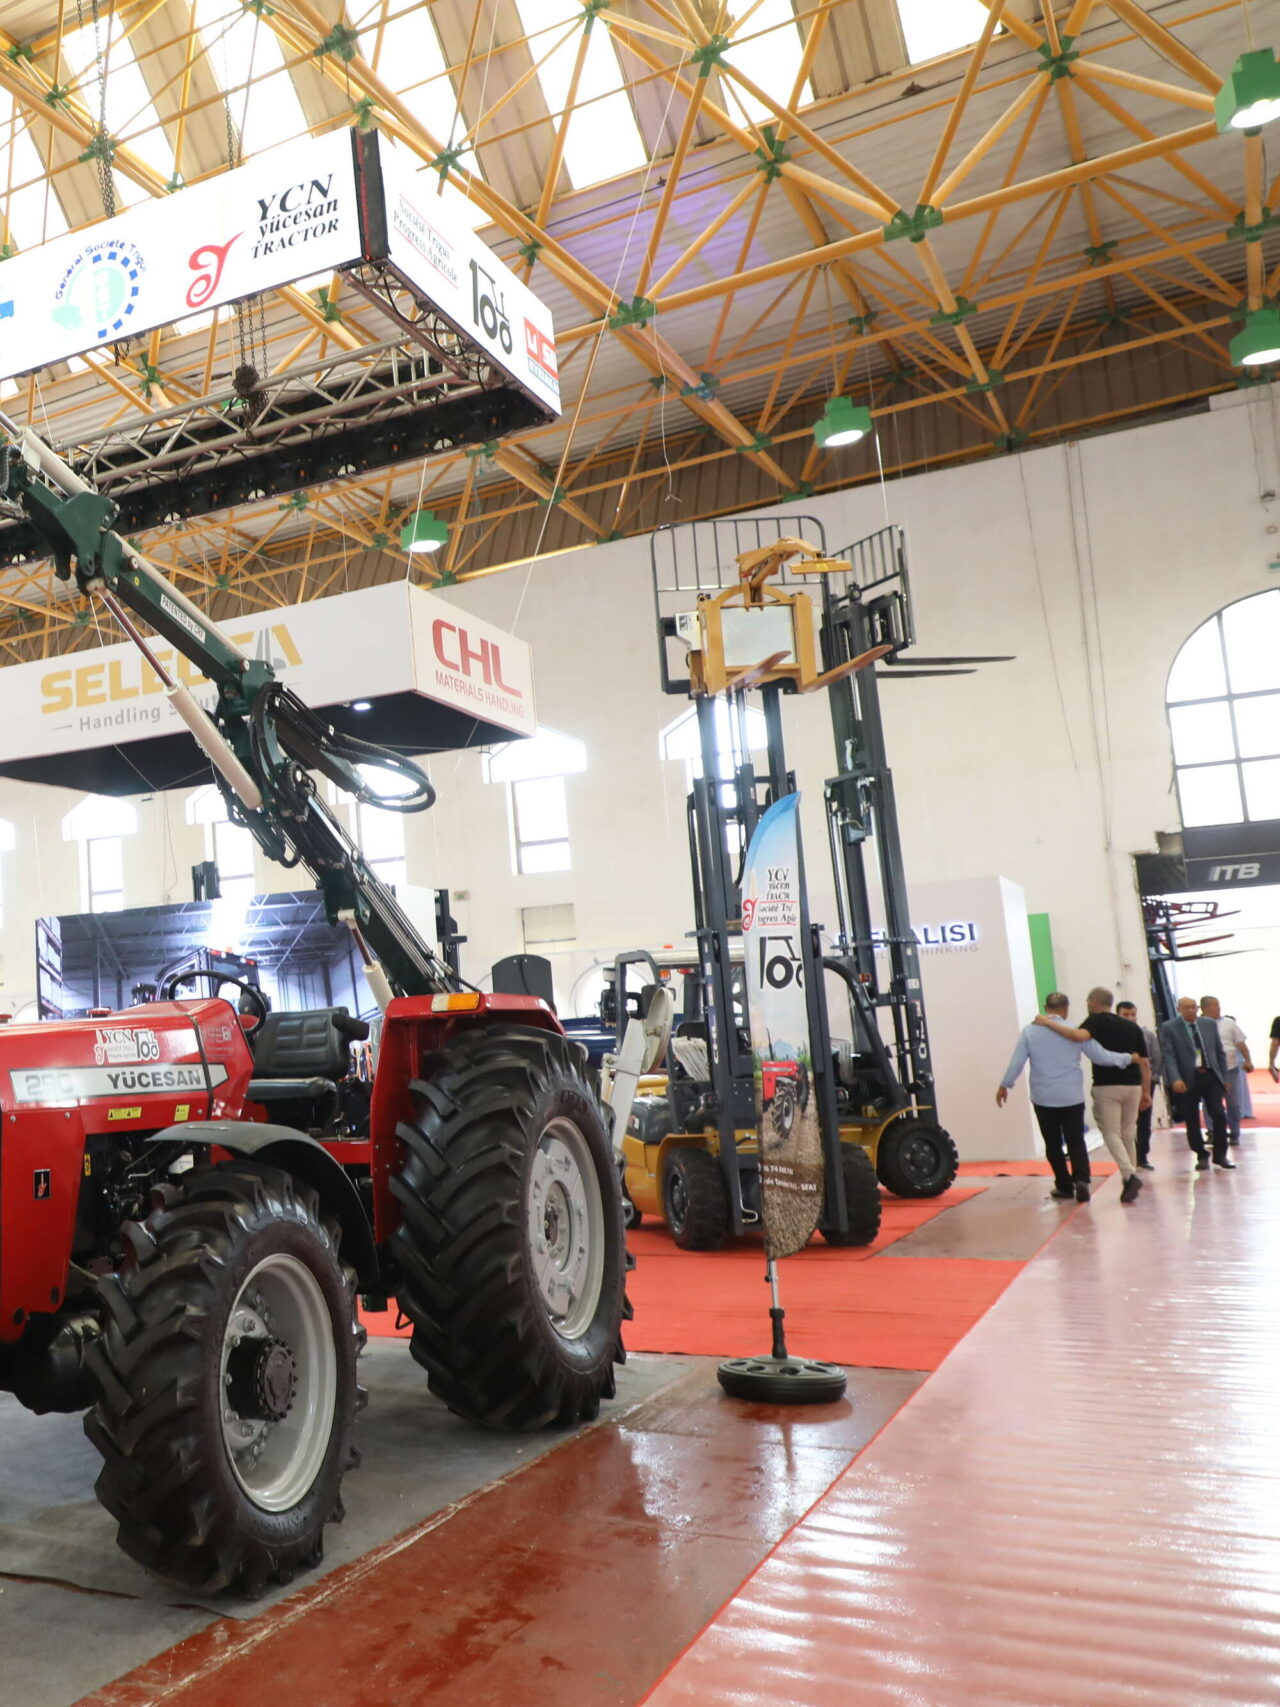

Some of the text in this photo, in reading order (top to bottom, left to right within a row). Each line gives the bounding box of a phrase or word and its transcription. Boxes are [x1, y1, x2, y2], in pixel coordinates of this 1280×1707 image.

[256, 173, 333, 222] YCN
[258, 199, 339, 240] yücesan
[251, 218, 339, 259] TRACTOR
[432, 618, 523, 699] CHL
[435, 669, 525, 719] MATERIALS HANDLING
[80, 706, 161, 732] Handling
[1210, 862, 1261, 882] ITB
[921, 944, 979, 956] HINKING
[104, 1030, 132, 1044] YCN
[107, 1069, 202, 1090] YÜCESAN
